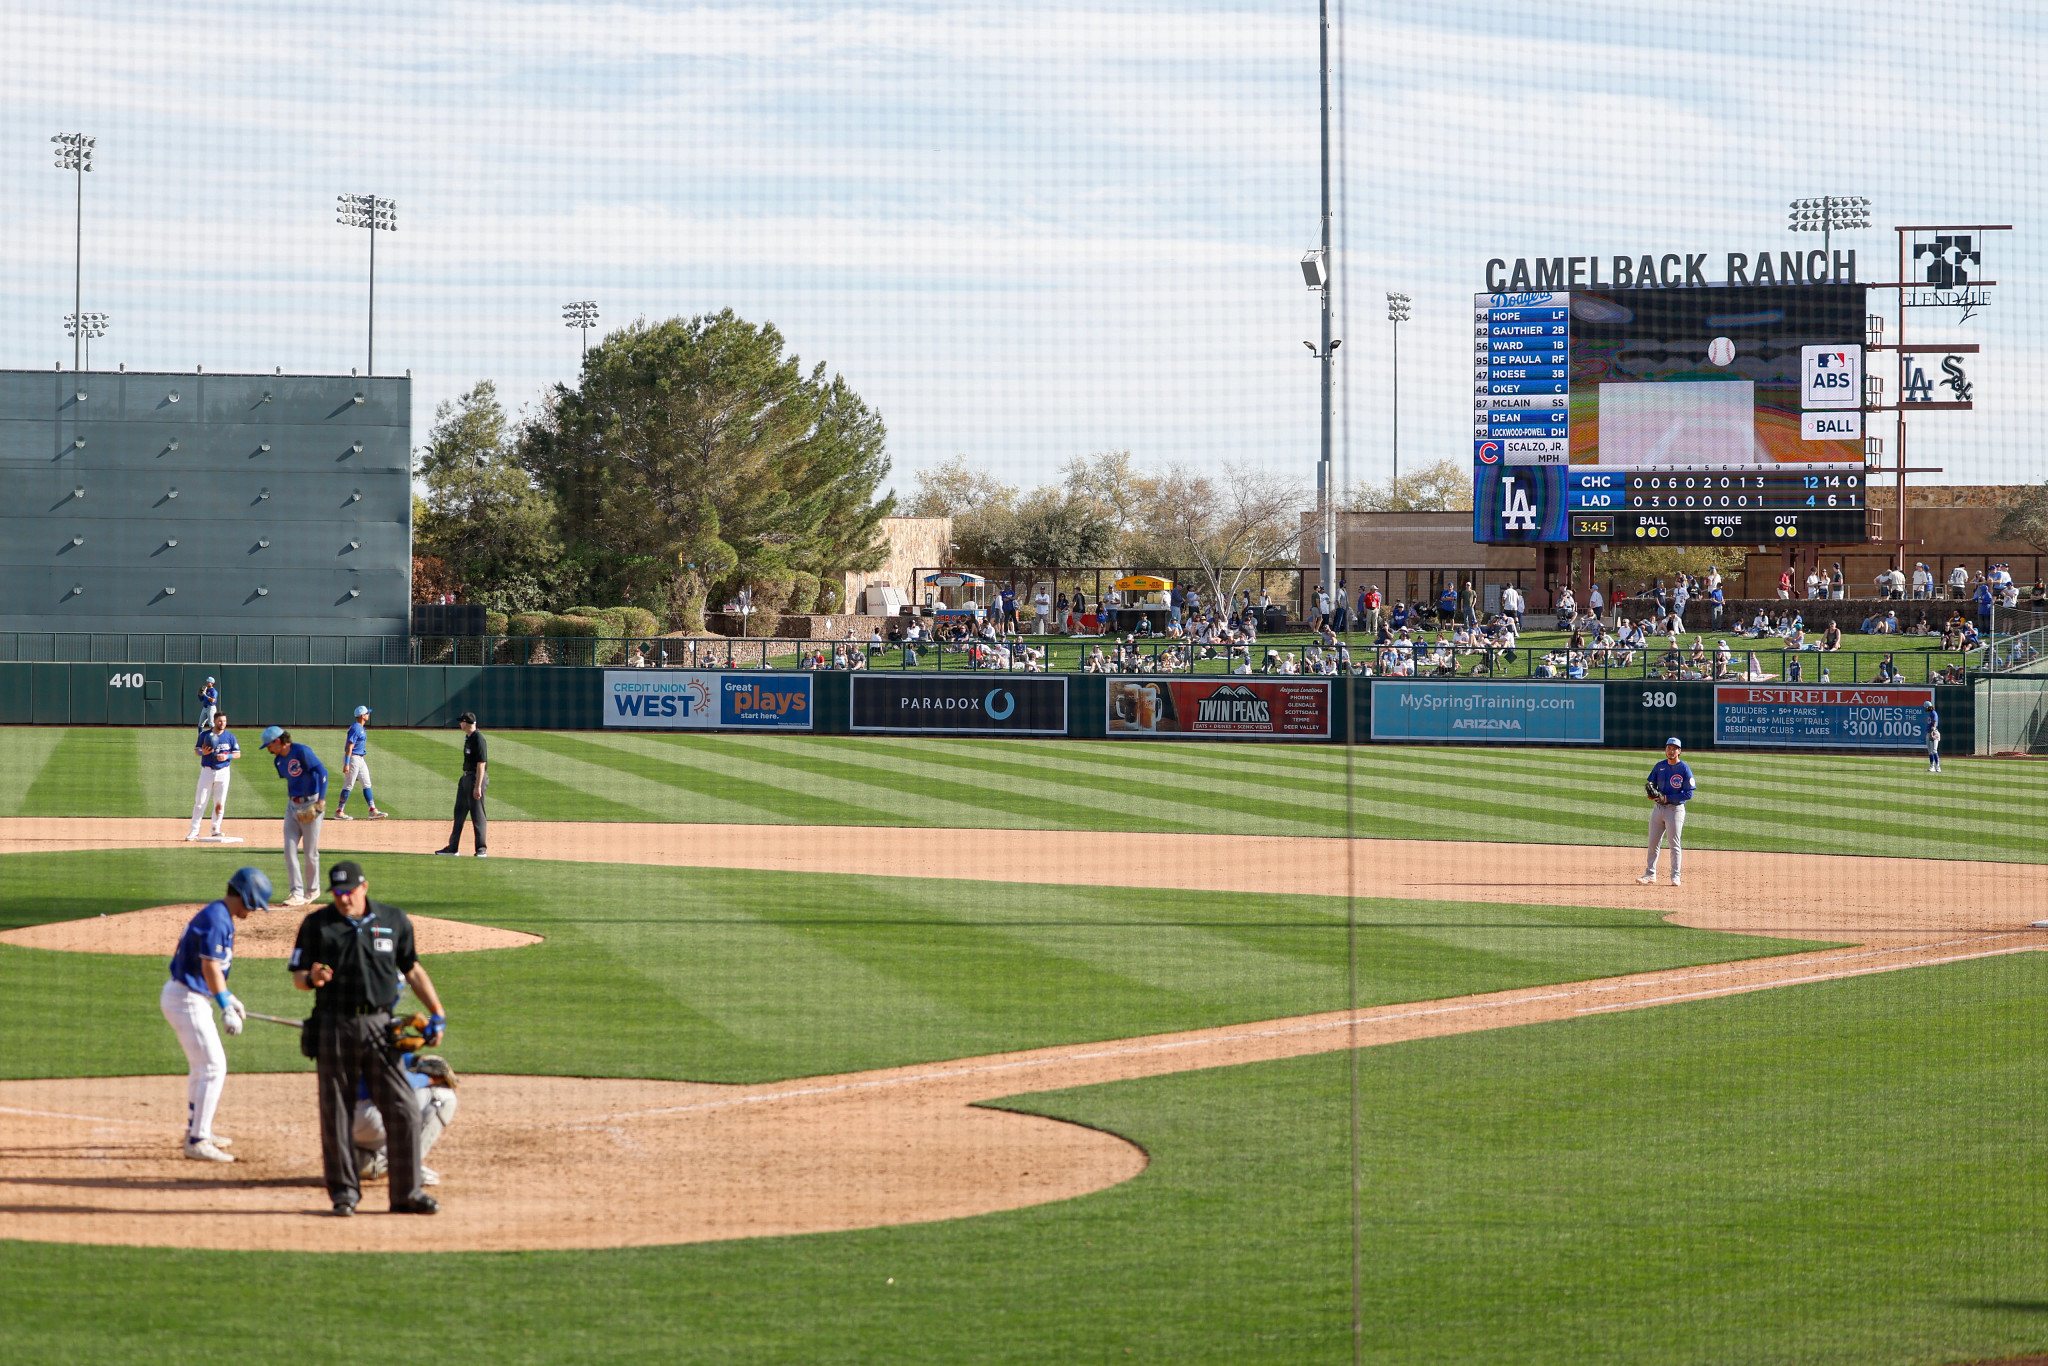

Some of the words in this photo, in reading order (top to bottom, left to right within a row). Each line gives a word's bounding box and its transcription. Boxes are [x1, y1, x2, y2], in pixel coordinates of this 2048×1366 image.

[1486, 253, 1708, 292] CAMELBACK
[1728, 250, 1856, 287] RANCH
[1493, 312, 1520, 320] HOPE
[1552, 311, 1565, 319] LF
[1493, 326, 1543, 335] GAUTHIER
[1552, 326, 1565, 334] 2B
[1493, 341, 1524, 350] WARD
[1553, 341, 1564, 349] 1B
[1493, 356, 1506, 364] DE
[1509, 355, 1541, 363] PAULA
[1552, 355, 1565, 363] RF
[1493, 370, 1526, 378] HOESE
[1902, 356, 1934, 402] LA
[1813, 373, 1850, 388] ABS
[1493, 385, 1520, 393] OKEY
[1555, 384, 1562, 392] C
[1493, 414, 1520, 422] DEAN
[1492, 428, 1546, 436] LOCKWOOD-POWELL
[1551, 428, 1565, 436] DH
[1817, 420, 1853, 432] BALL
[1508, 443, 1548, 452] SCALZO,
[1550, 443, 1564, 451] JR.
[1581, 476, 1610, 487] CHC
[1634, 478, 1642, 488] 0
[1651, 478, 1660, 488] 0
[1669, 478, 1677, 488] 6
[1686, 478, 1694, 488] 0
[1704, 477, 1711, 488] 2
[1721, 477, 1729, 488] 0
[1740, 477, 1745, 488] 1
[1756, 477, 1764, 488] 3
[1803, 477, 1818, 488] 12
[1824, 476, 1840, 488] 14
[1847, 476, 1857, 488] 0
[1502, 476, 1536, 530] LA
[1582, 495, 1610, 506] LAD
[1634, 496, 1642, 507] 0
[1652, 496, 1659, 507] 3
[1668, 496, 1677, 507] 0
[1686, 496, 1694, 507] 0
[1703, 496, 1712, 507] 0
[1721, 496, 1729, 506] 0
[1738, 496, 1747, 506] 0
[1758, 496, 1762, 506] 1
[1806, 495, 1815, 507] 4
[1827, 495, 1837, 506] 6
[1850, 495, 1856, 506] 1
[1640, 517, 1667, 525] BALL
[1704, 516, 1742, 525] STRIKE
[1775, 516, 1797, 524] OUT
[1580, 522, 1607, 532] 3:45
[110, 673, 144, 688] 410
[725, 682, 752, 691] Great
[614, 683, 651, 692] CREDIT
[652, 684, 686, 692] UNION
[735, 685, 806, 714] plays
[901, 698, 979, 710] PARADOX
[1400, 694, 1575, 712] MySpringTraining.com
[1642, 692, 1677, 707] 380
[614, 695, 695, 717] WEST
[1199, 700, 1230, 721] TWIN
[1233, 701, 1270, 721] PEAKS
[1849, 708, 1903, 720] HOMES
[1452, 718, 1522, 730] ARIZONA
[1843, 720, 1921, 737] $300,000s
